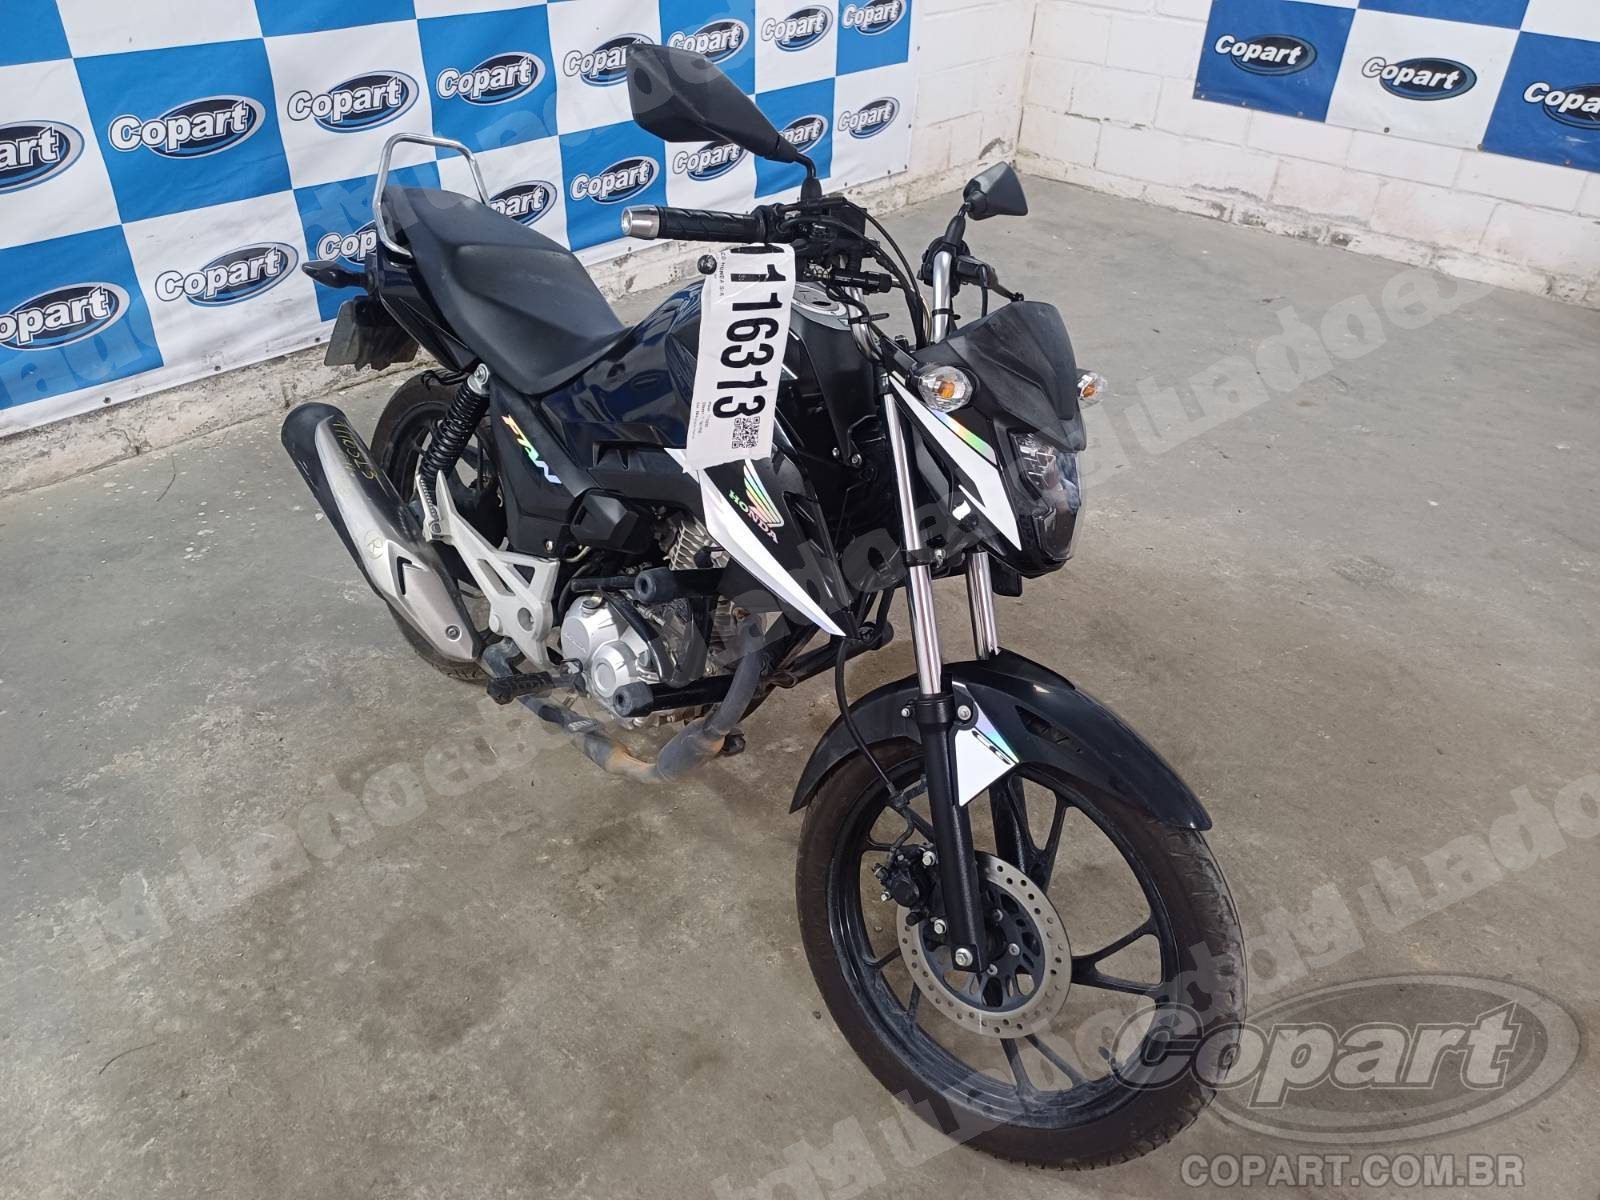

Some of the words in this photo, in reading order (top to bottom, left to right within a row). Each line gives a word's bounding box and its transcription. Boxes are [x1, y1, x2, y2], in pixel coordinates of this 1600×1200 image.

[760, 9, 826, 46] Copart
[842, 1, 899, 31] Copart
[1214, 34, 1302, 66] Copart
[436, 53, 533, 104] Copart
[1361, 56, 1460, 91] Copart
[287, 72, 404, 123] Copart
[838, 99, 894, 132] Copart
[1522, 81, 1600, 117] Copa
[108, 97, 250, 153] Copart
[0, 124, 60, 171] art
[672, 142, 741, 177] Copart
[569, 157, 649, 204] Copart
[316, 230, 377, 261] Cop
[155, 245, 282, 302] Copart
[0, 284, 111, 346] opart
[728, 489, 779, 545] HONDA
